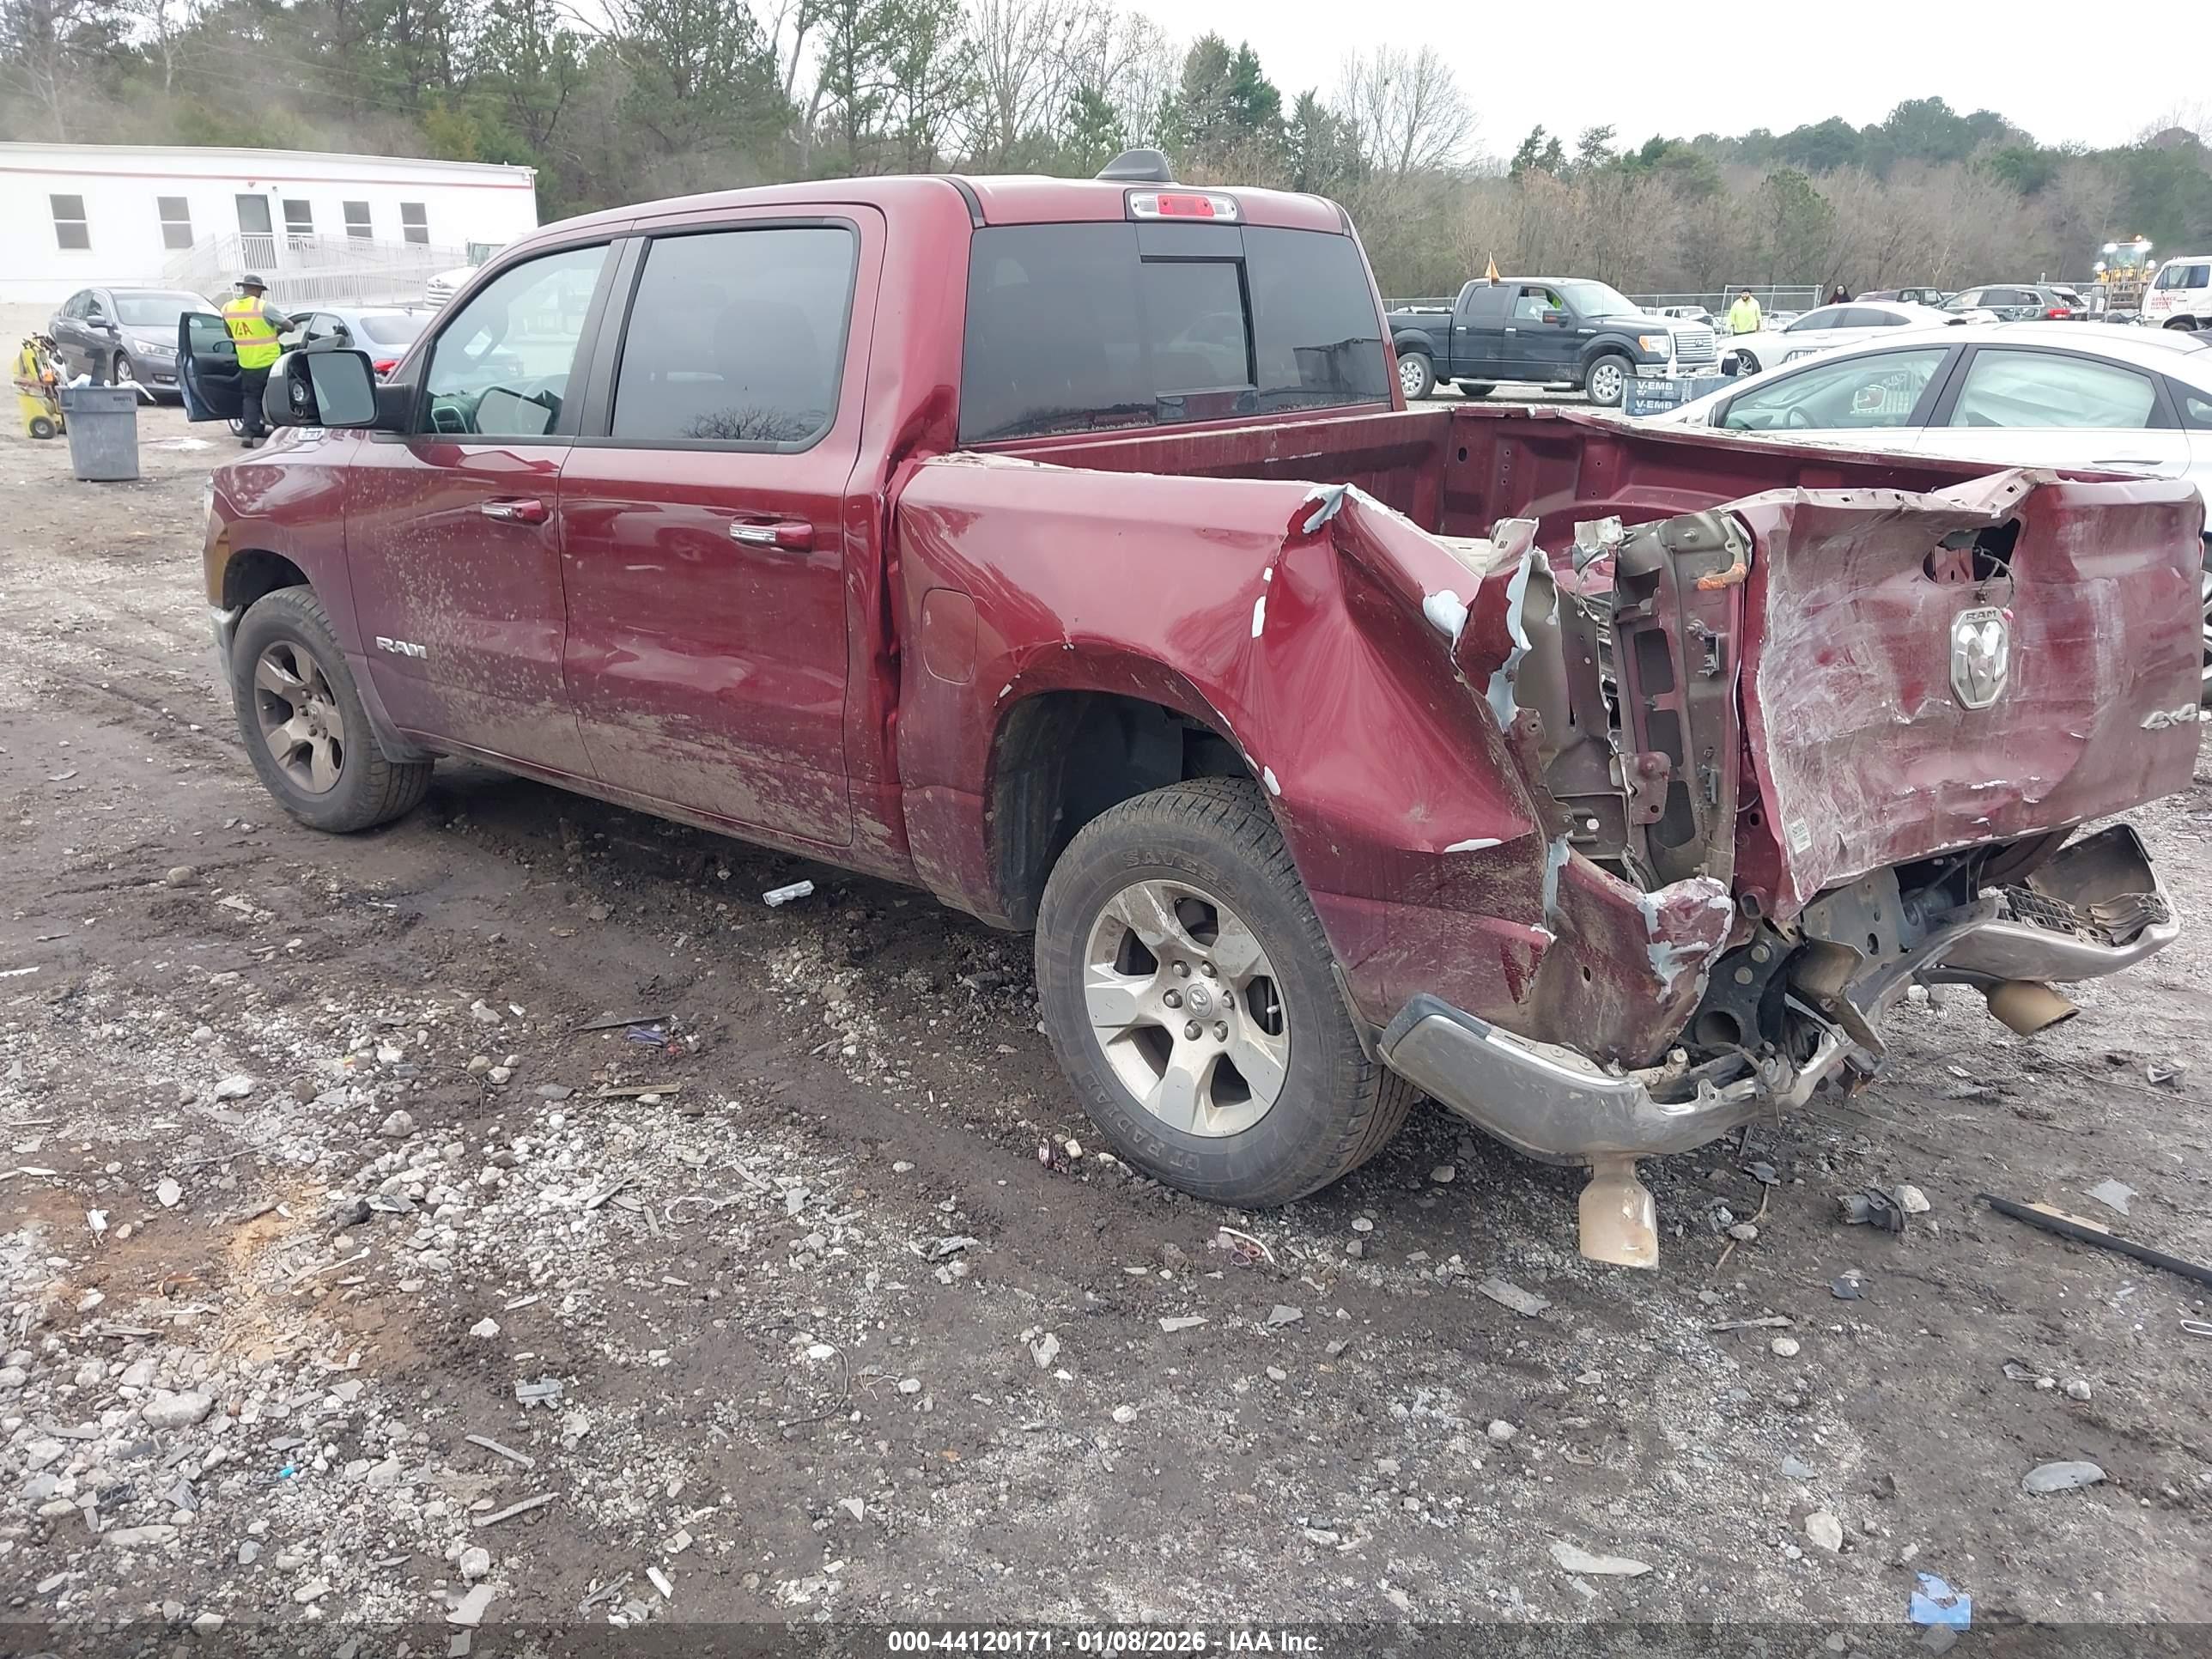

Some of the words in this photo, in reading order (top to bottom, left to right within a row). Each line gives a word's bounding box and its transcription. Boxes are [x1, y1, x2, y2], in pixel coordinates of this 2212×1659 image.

[1966, 610, 1997, 620] RAM
[375, 636, 428, 660] RAM
[1123, 851, 1237, 899] SAVERO
[1079, 1071, 1165, 1158] RADIAL
